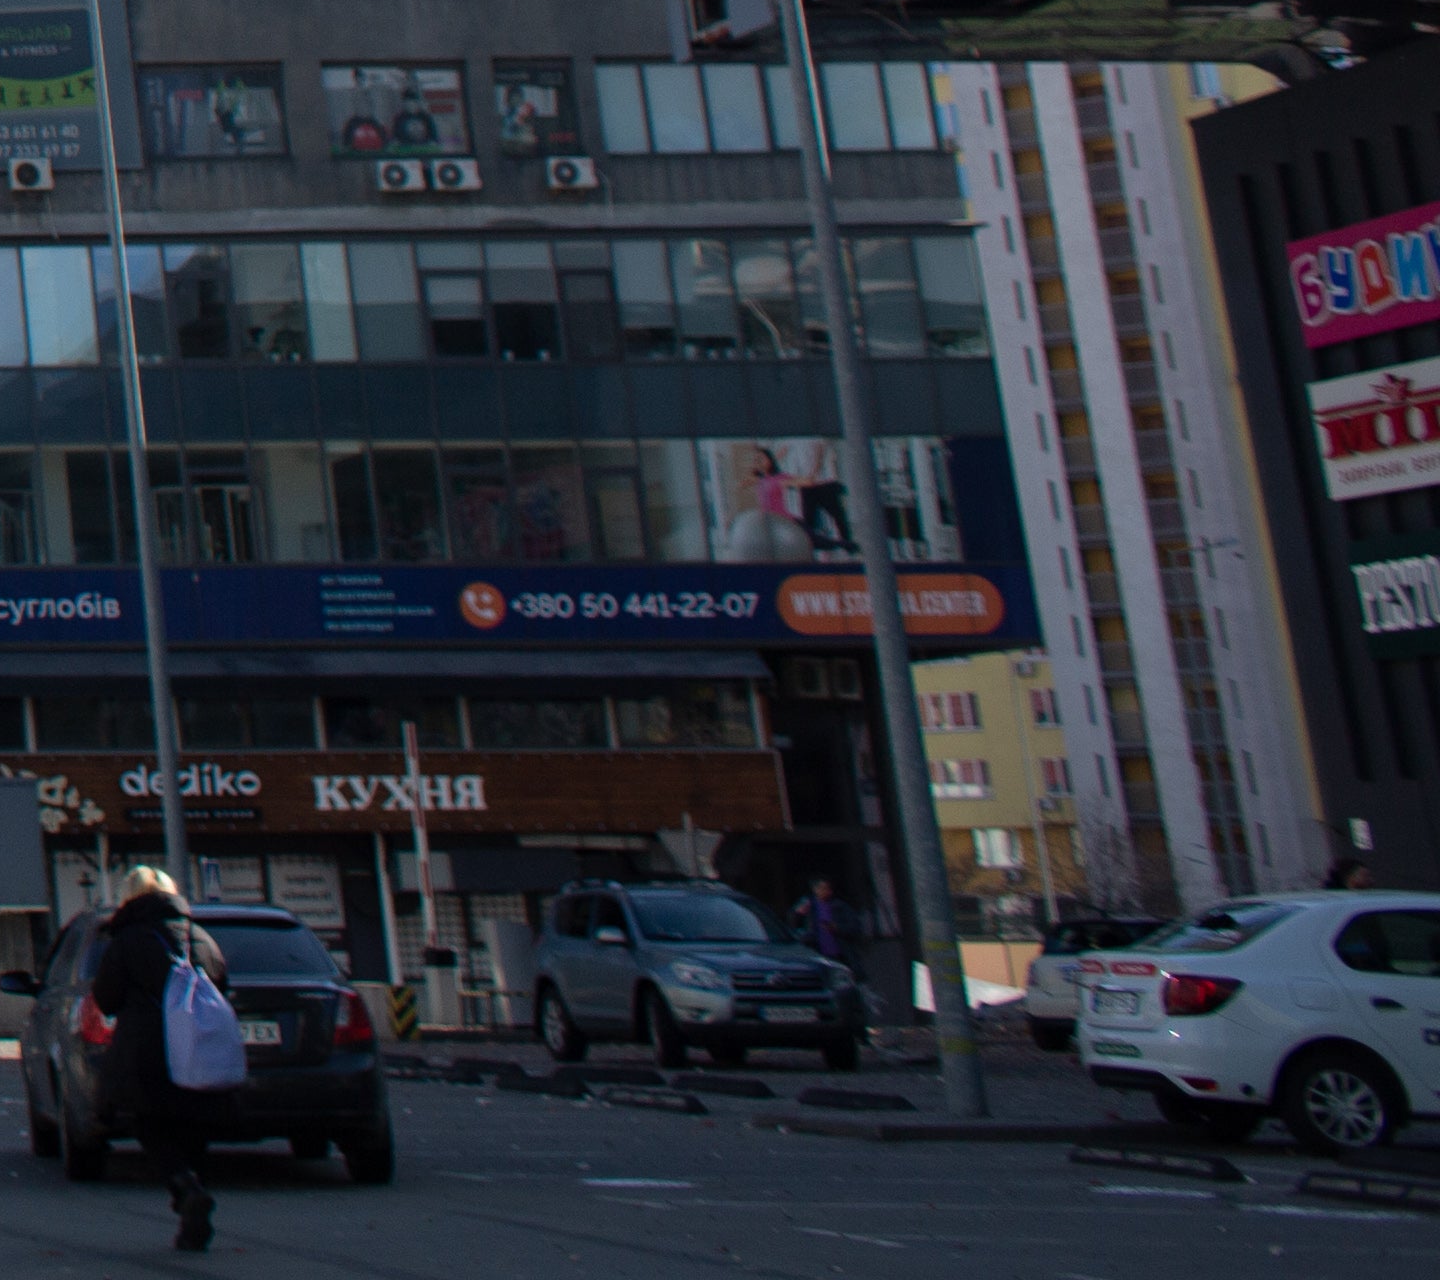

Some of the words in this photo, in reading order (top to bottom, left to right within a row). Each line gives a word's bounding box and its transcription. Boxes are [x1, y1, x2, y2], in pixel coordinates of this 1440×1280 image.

[511, 592, 575, 619] +380
[581, 592, 619, 618] 50
[623, 592, 759, 618] 441-22-07
[312, 775, 487, 810] КУХНЯ
